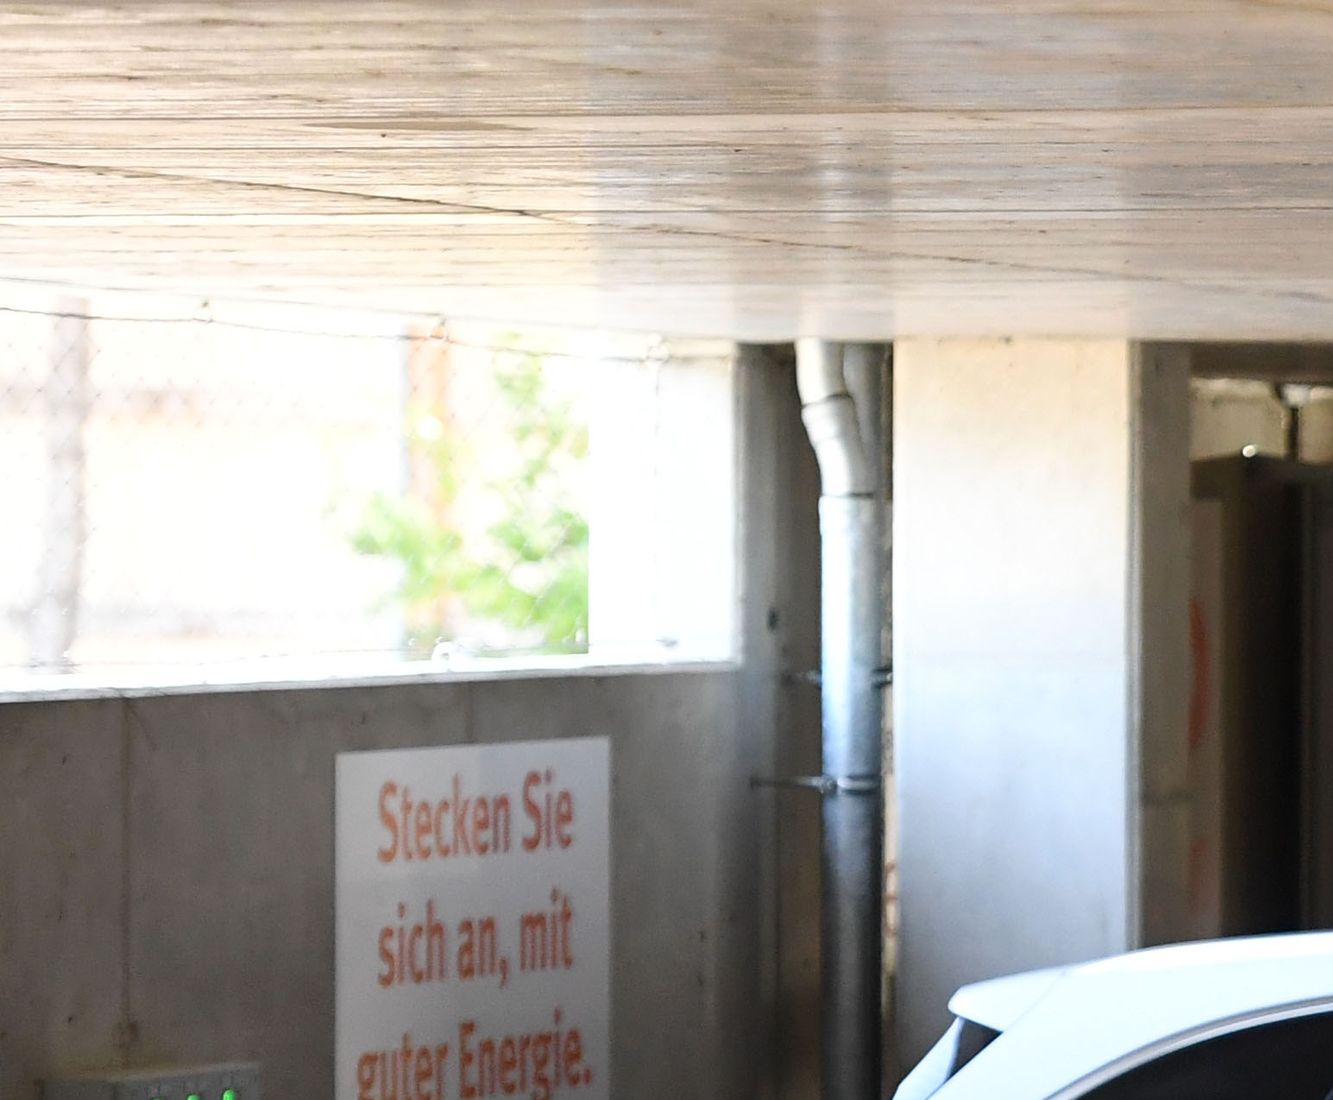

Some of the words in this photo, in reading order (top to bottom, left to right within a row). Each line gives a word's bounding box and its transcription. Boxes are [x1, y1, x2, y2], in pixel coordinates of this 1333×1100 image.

[377, 772, 511, 863] Stecken
[522, 768, 573, 851] Sie
[378, 898, 446, 988] sich
[457, 916, 509, 988] an,
[519, 887, 573, 971] mit
